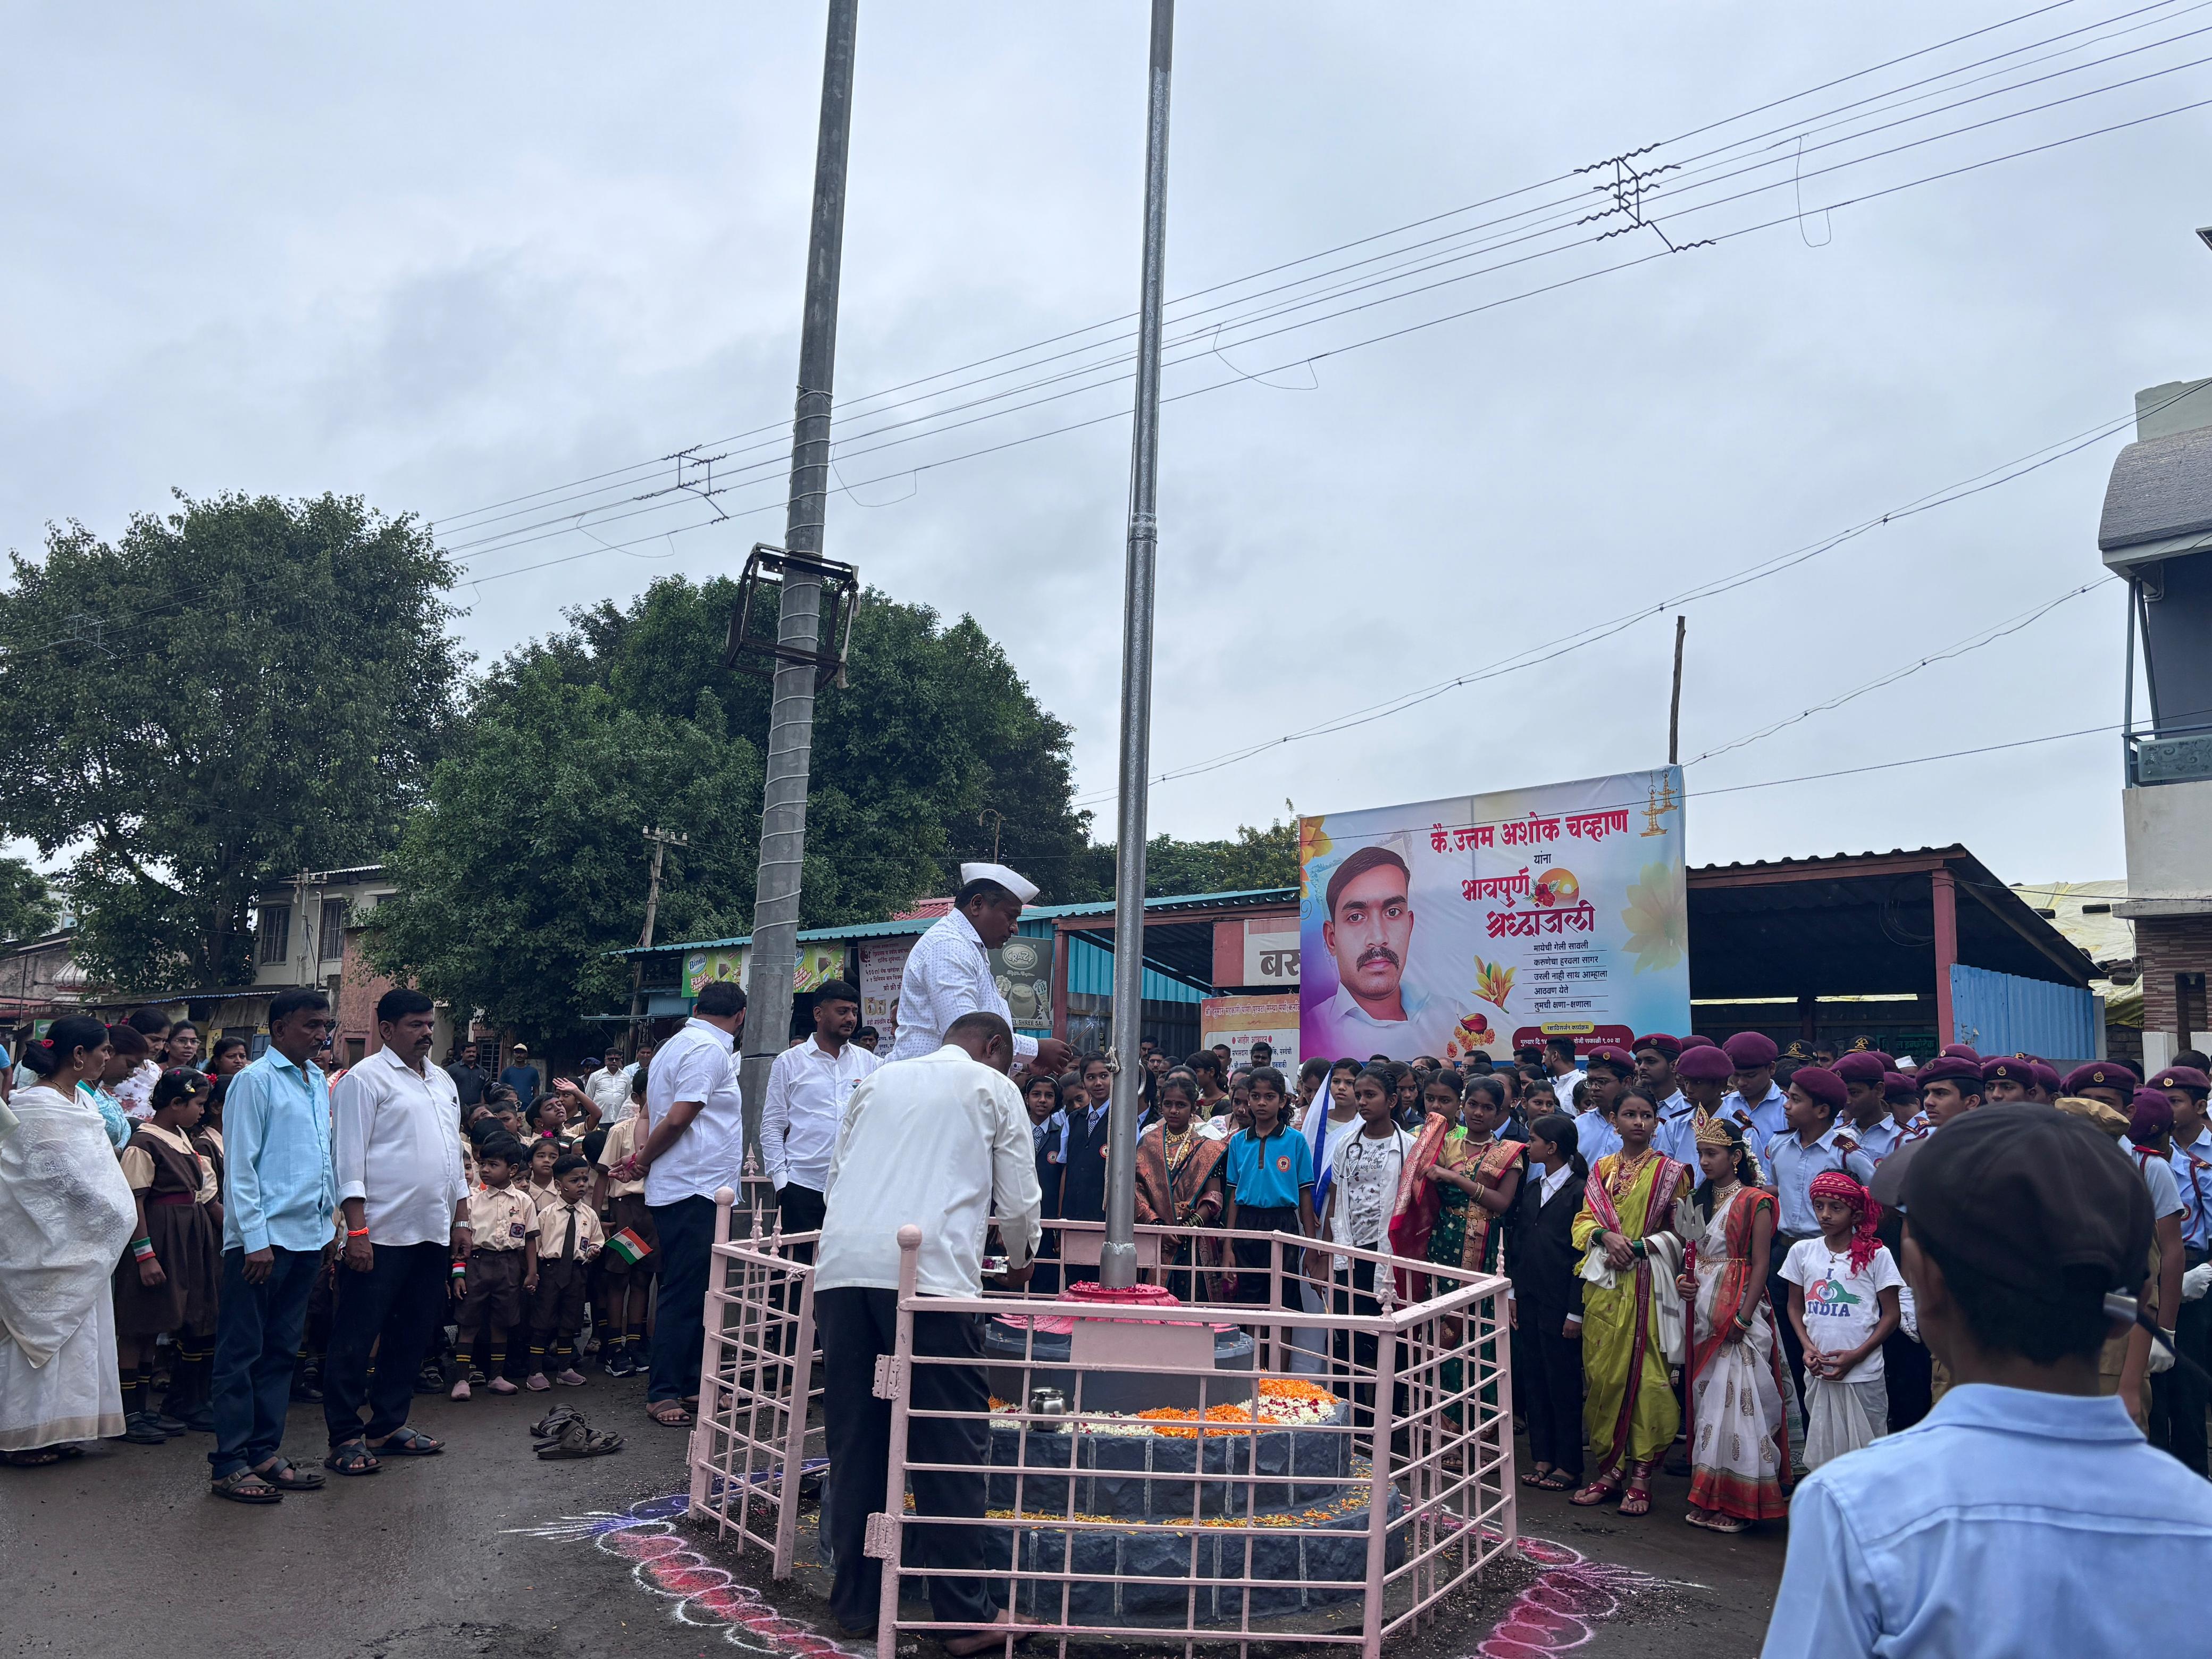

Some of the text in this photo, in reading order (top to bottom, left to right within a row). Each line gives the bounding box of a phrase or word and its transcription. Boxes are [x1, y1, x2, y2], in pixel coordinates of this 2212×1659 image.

[1501, 811, 1560, 846] अशोक
[1565, 809, 1629, 842] चव्हाण
[1534, 851, 1552, 865] यांना
[1534, 940, 1588, 952] मायेची गेली सावली
[689, 957, 706, 969] Bindu
[1534, 956, 1558, 966] करुणेचा
[1560, 957, 1580, 966] हरवला
[1534, 970, 1549, 981] उरली
[1552, 970, 1564, 981] नाही
[1582, 970, 1607, 979] आम्हाला
[1559, 984, 1569, 994] येते
[1535, 999, 1551, 1012] तुमची
[1237, 1035, 1250, 1044] जाहीर
[1825, 1268, 1834, 1280] I
[1808, 1301, 1850, 1317] INDIA
